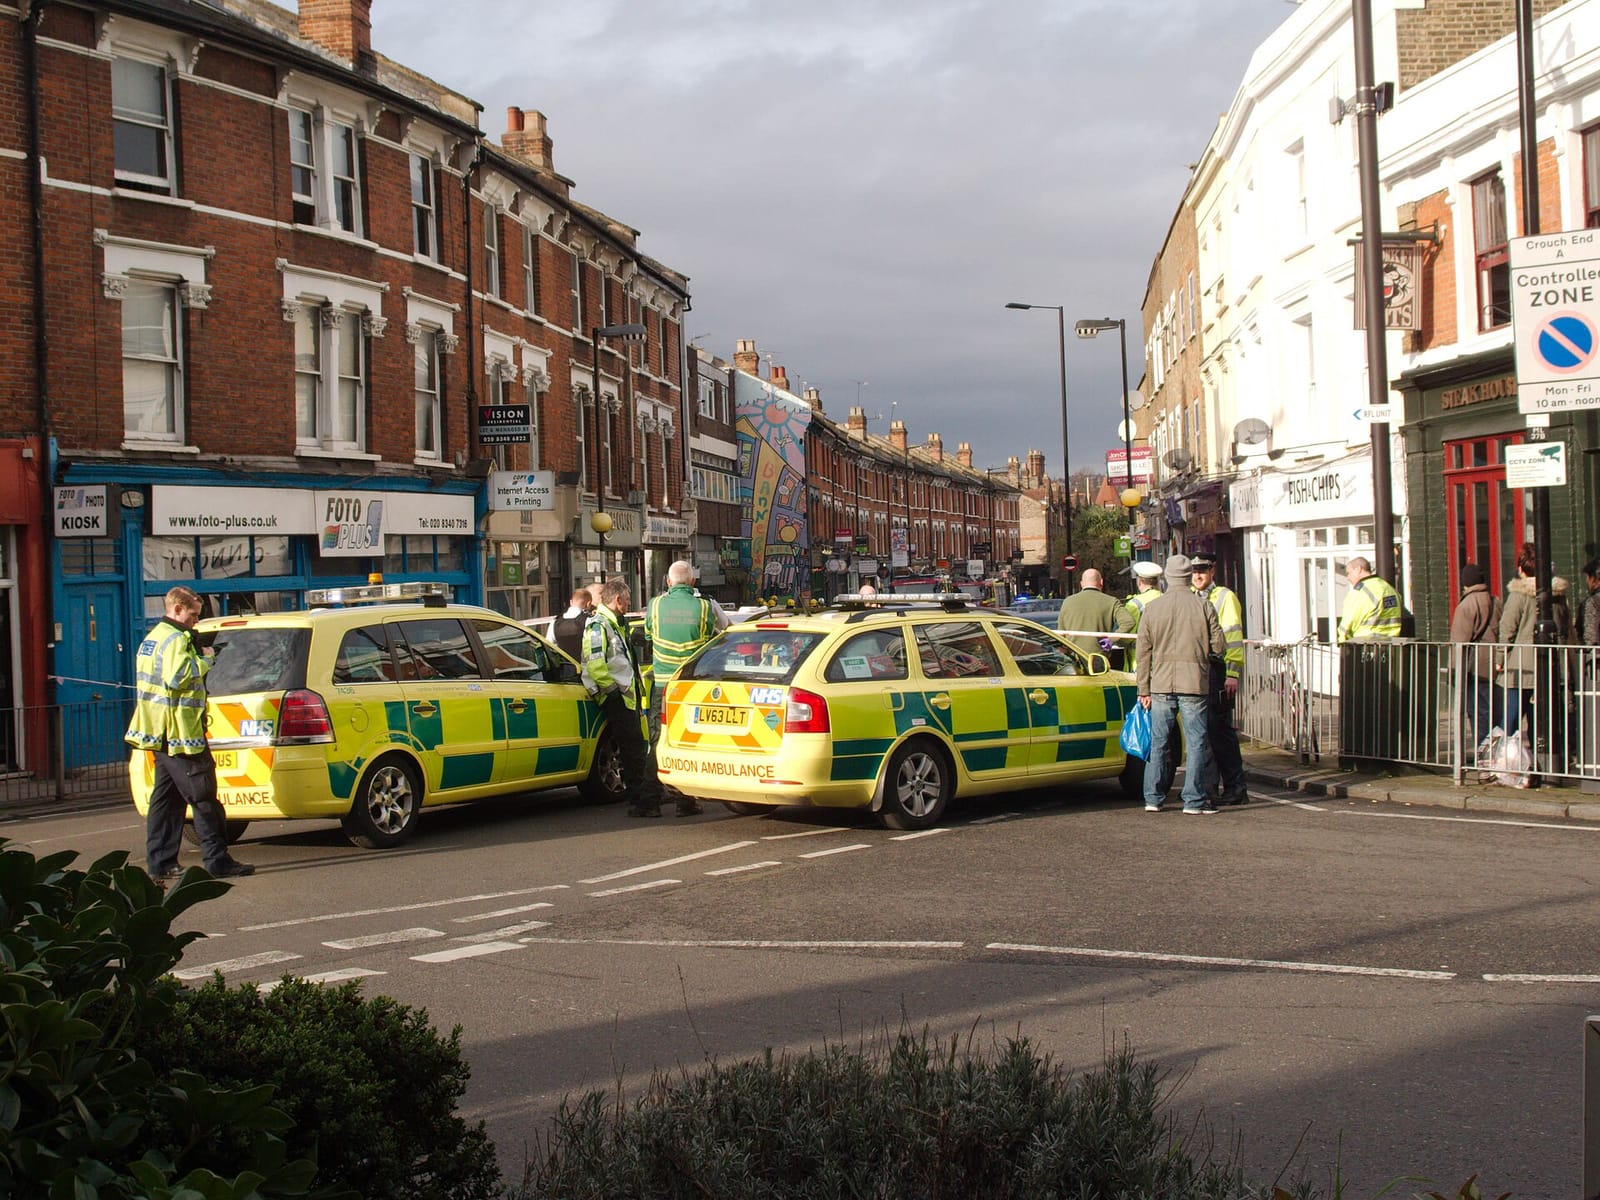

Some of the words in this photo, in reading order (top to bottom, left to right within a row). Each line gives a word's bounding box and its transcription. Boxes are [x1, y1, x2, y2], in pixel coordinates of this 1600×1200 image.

[1526, 237, 1567, 250] Crouch
[1571, 234, 1594, 245] End
[1556, 249, 1565, 258] A
[1517, 267, 1600, 287] Controlle
[1530, 286, 1594, 307] ZONE
[1441, 385, 1479, 410] STEAK
[1545, 386, 1568, 396] Mon
[1577, 384, 1592, 393] Fri
[1537, 399, 1549, 408] 10
[484, 408, 524, 419] VISION
[59, 489, 76, 500] FOTO
[497, 487, 523, 495] Internet
[524, 486, 550, 494] Access
[85, 495, 105, 508] PHOTO
[506, 498, 511, 506] &
[514, 497, 542, 507] Printing
[326, 497, 362, 522] FOTO
[61, 515, 100, 530] KIOSK
[168, 514, 278, 530] www.foto-plus.co.uk
[418, 517, 429, 528] Tel:
[429, 518, 440, 528] 020
[337, 523, 373, 550] PLUS
[750, 687, 783, 705] NHS
[699, 708, 724, 723] LV63
[240, 719, 274, 737] NHS
[661, 756, 698, 773] LONDON
[701, 762, 775, 778] AMBULANCE
